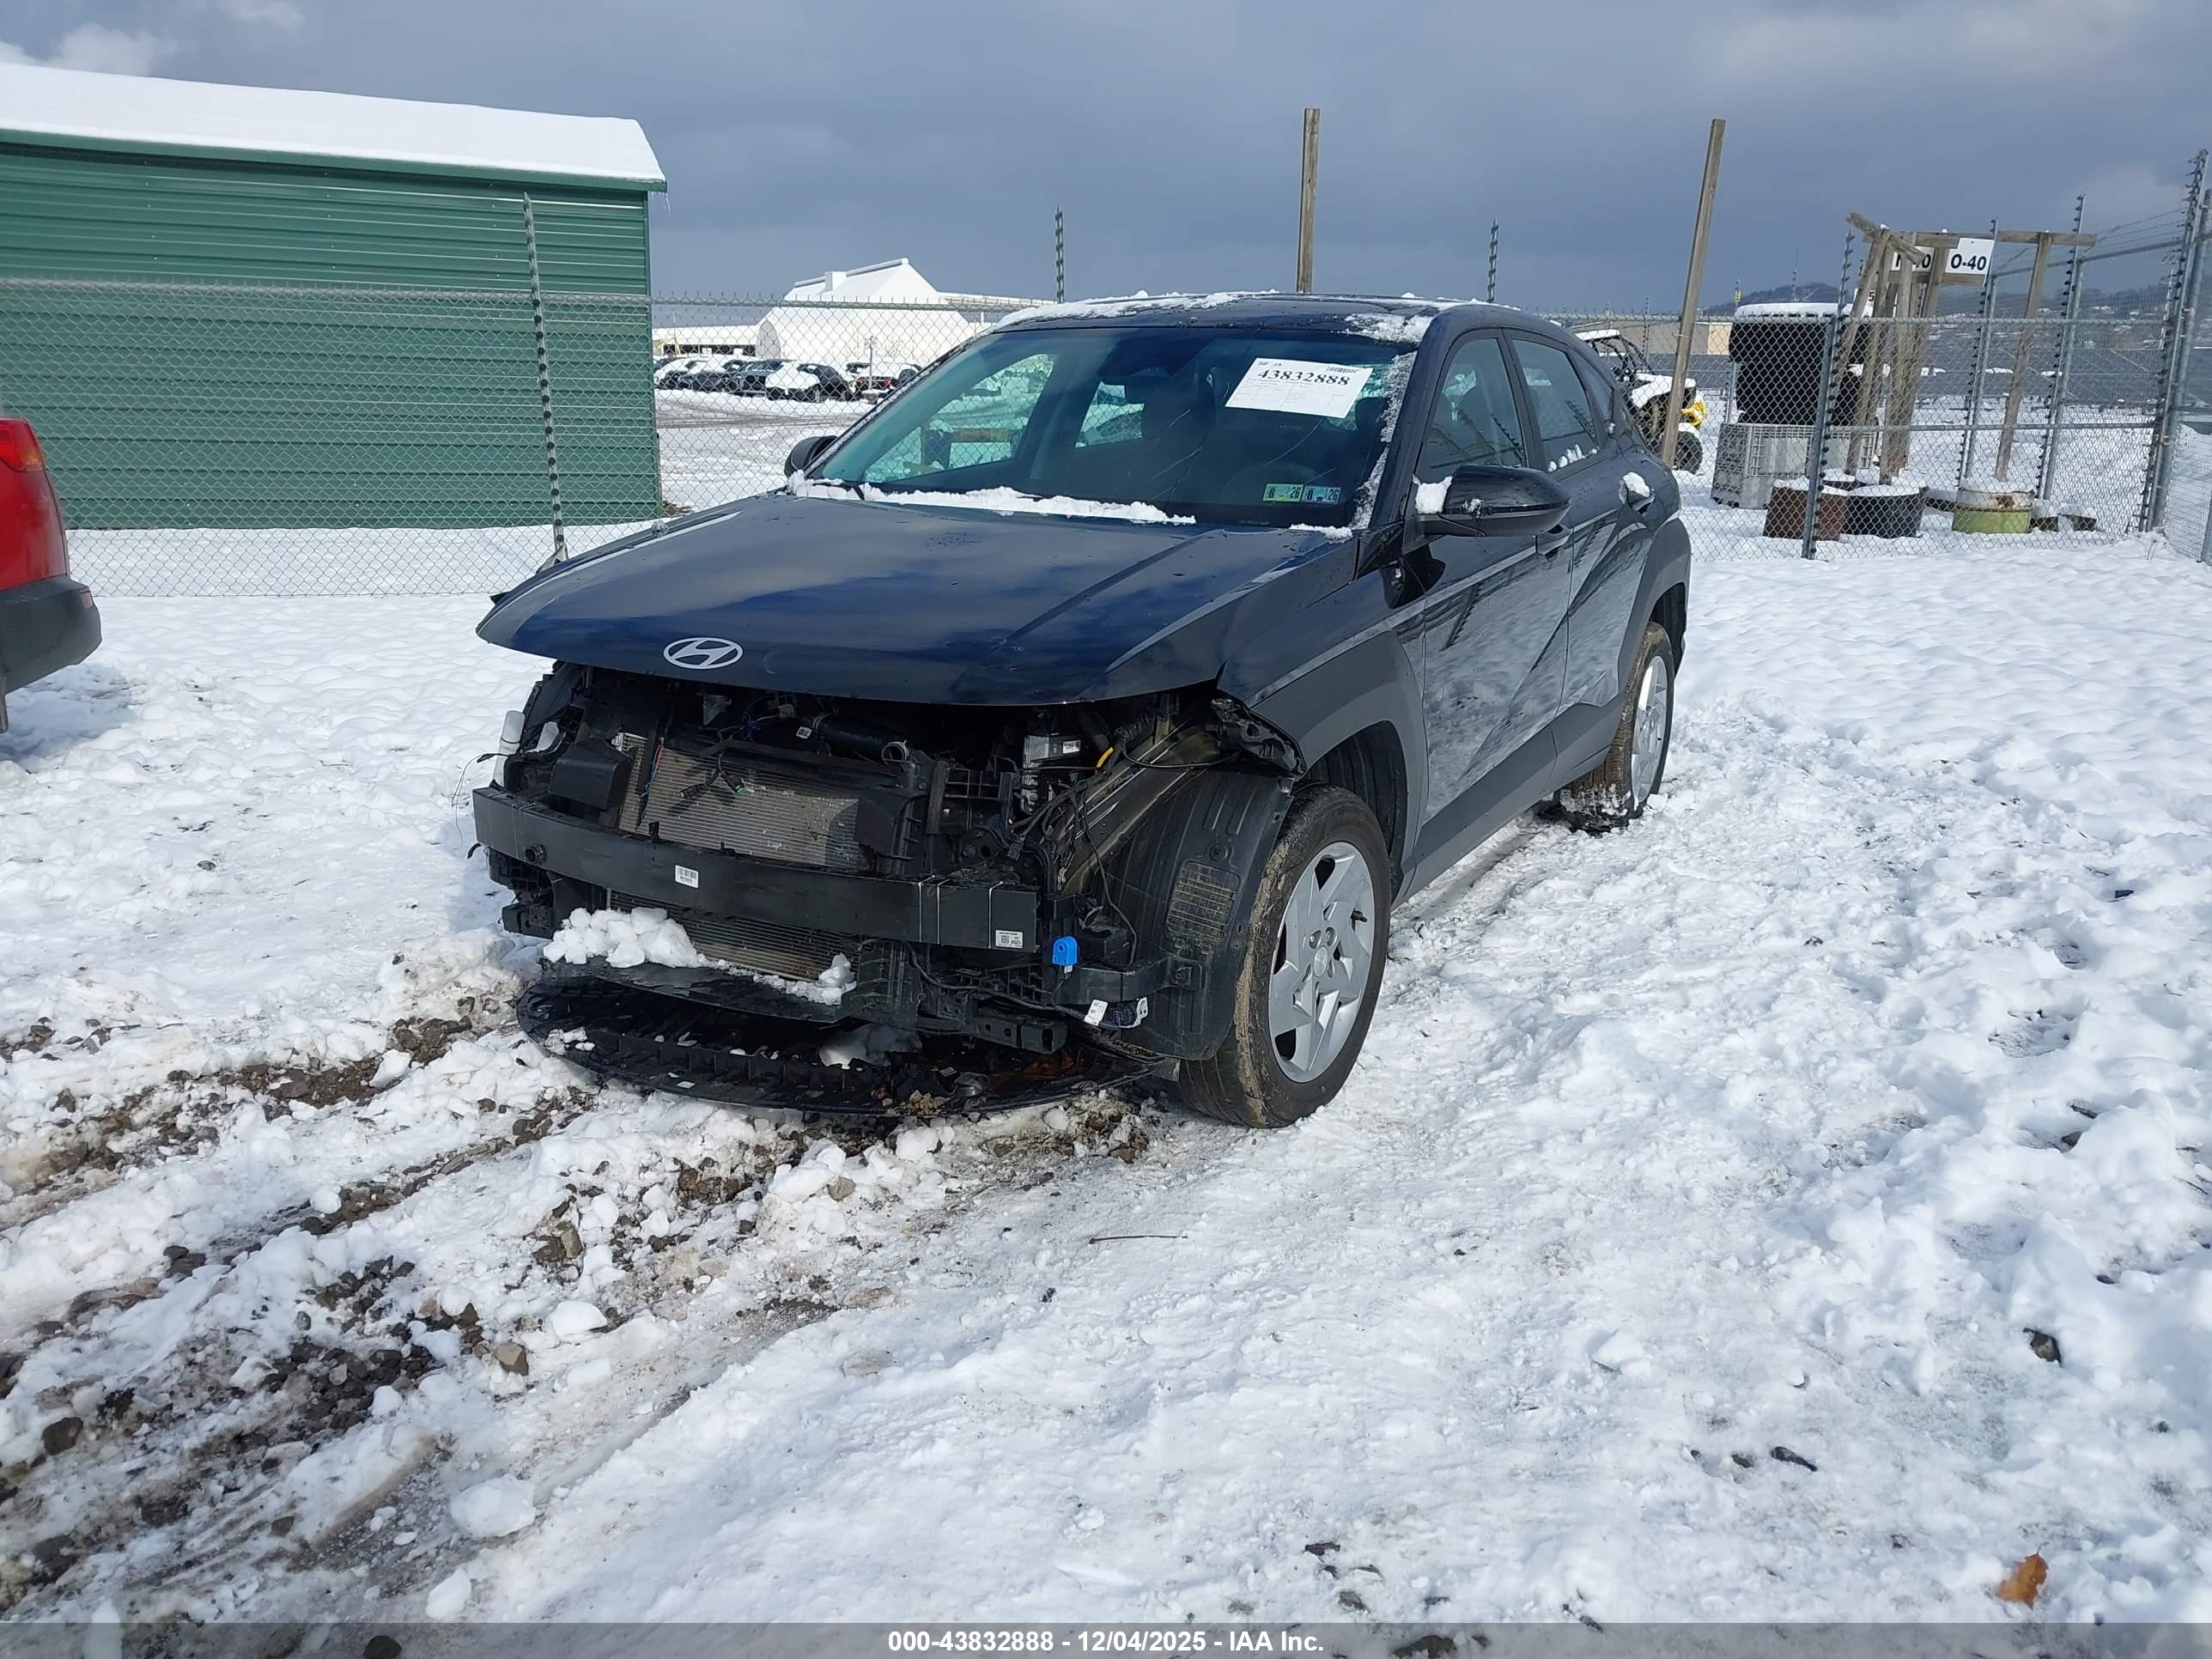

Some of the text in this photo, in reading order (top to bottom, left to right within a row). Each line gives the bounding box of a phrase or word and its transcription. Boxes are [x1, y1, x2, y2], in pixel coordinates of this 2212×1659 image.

[1257, 369, 1351, 386] 43832888
[1290, 486, 1302, 499] 26
[1328, 489, 1340, 501] 26
